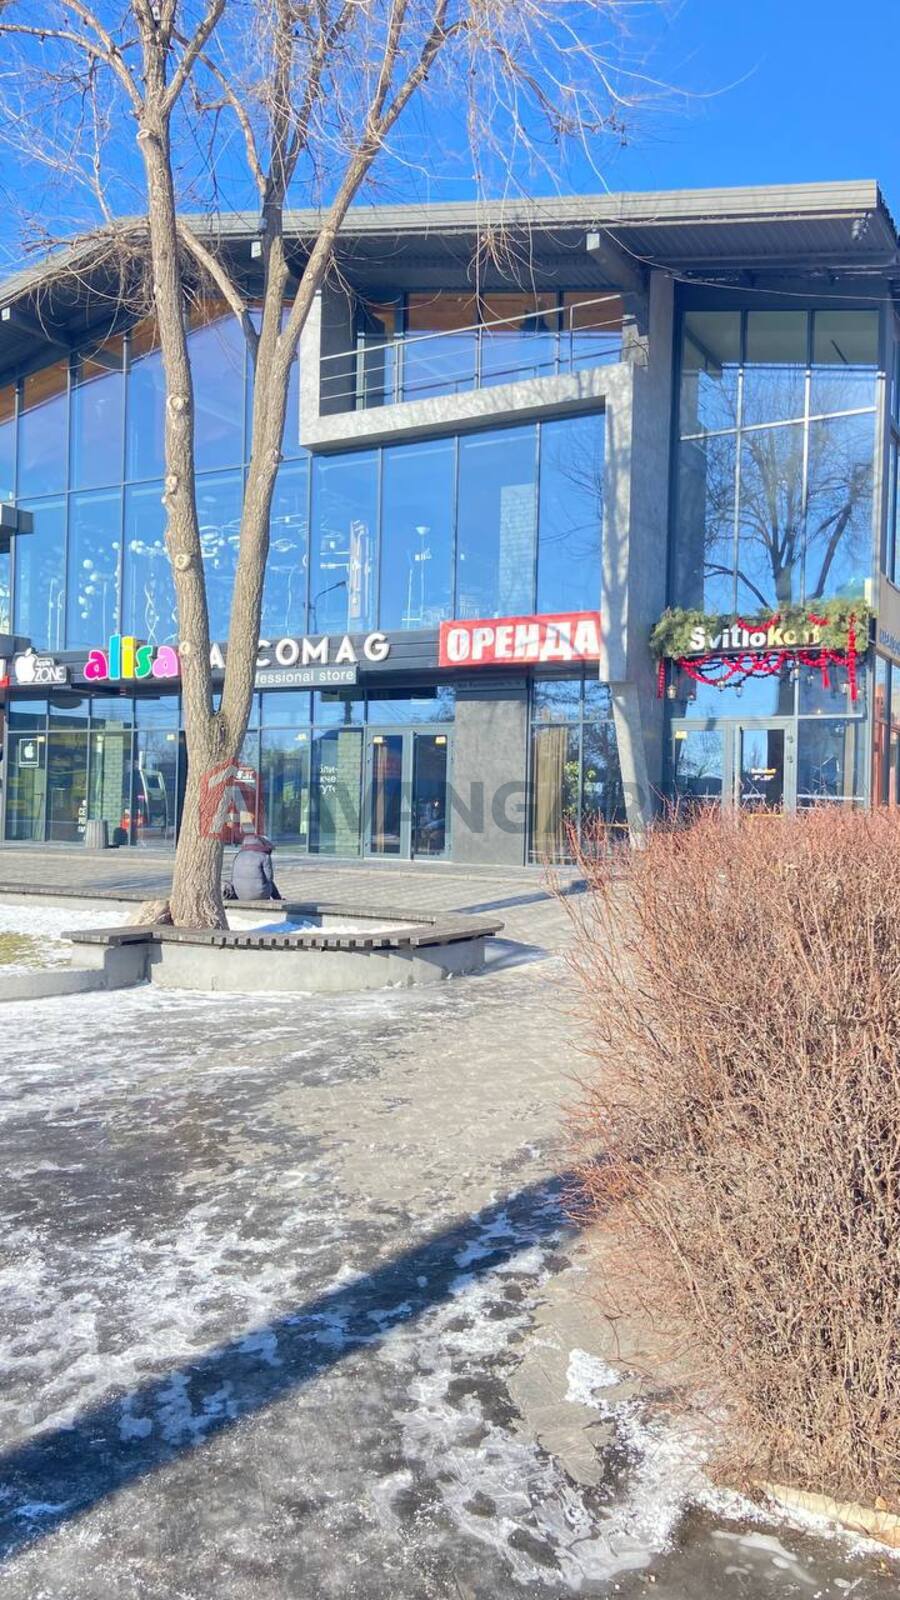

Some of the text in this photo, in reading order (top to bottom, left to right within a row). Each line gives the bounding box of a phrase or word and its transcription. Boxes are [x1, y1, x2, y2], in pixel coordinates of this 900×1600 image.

[83, 634, 180, 681] alisa
[204, 632, 392, 669] ACOMAG
[446, 619, 600, 662] ОРЕНДА
[34, 665, 65, 682] ZONE
[255, 669, 354, 685] fessional store
